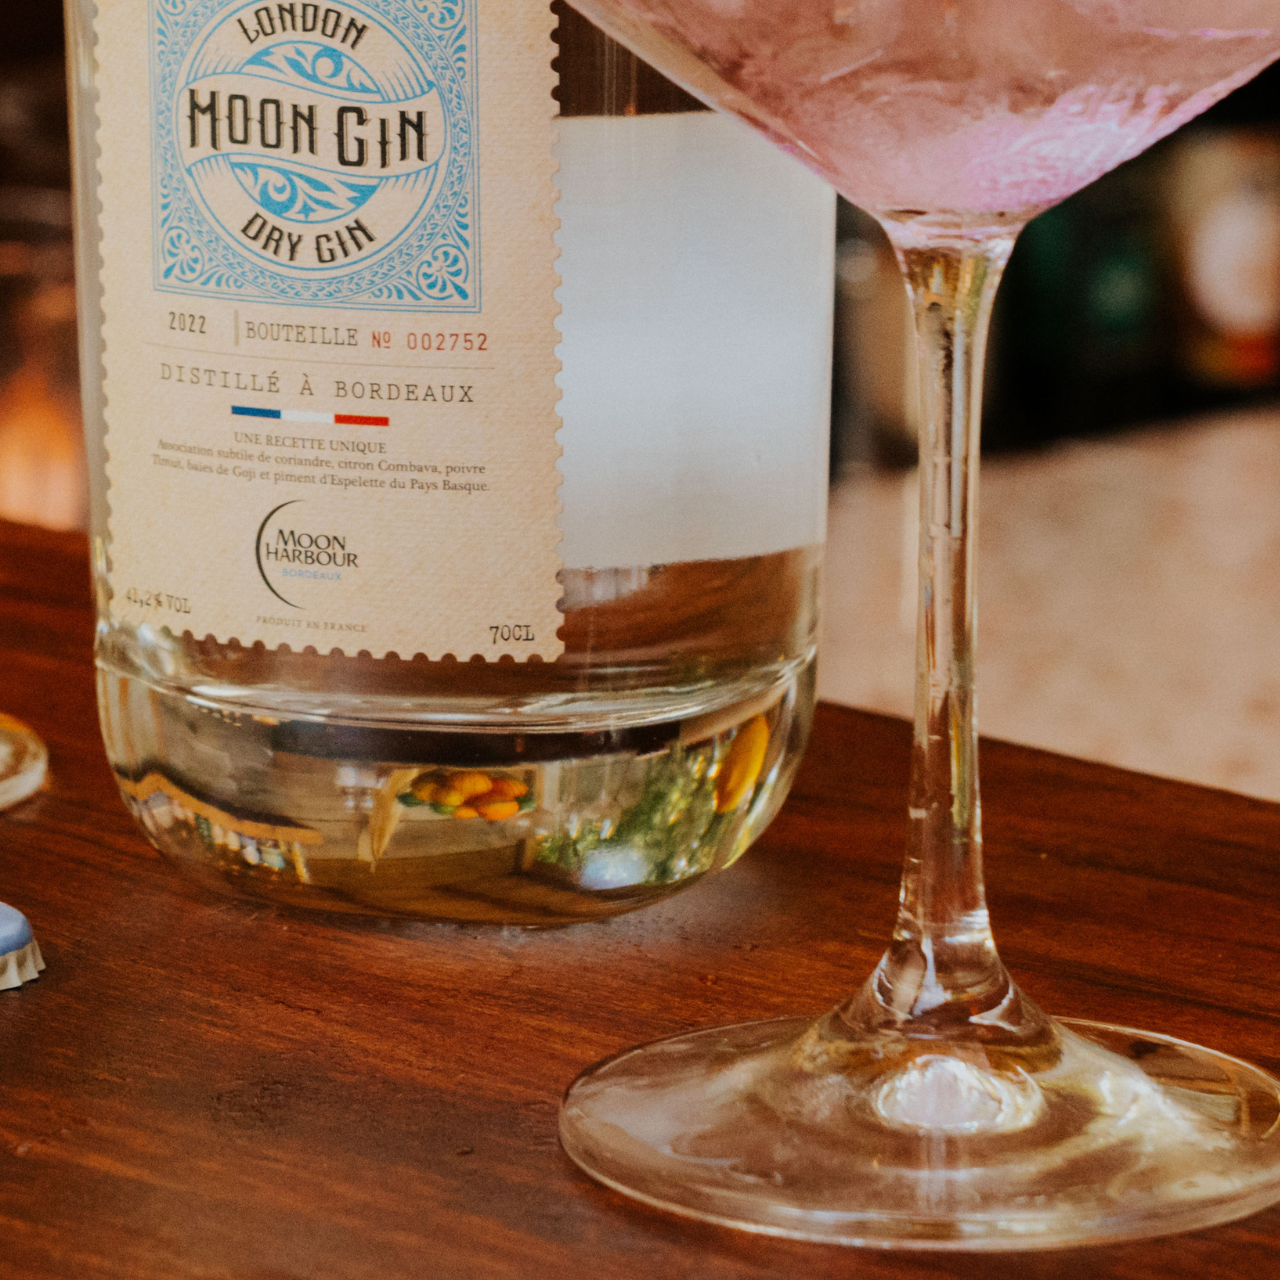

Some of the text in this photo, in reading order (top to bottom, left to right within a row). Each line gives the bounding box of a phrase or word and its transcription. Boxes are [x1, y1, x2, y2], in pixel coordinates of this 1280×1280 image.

[236, 2, 371, 50] LONDON
[187, 88, 430, 169] MOON GIN
[240, 211, 377, 265] DRY GIN
[168, 311, 208, 334] 2022
[245, 321, 359, 347] BOUTEILLE
[406, 332, 489, 351] 002752
[160, 363, 474, 403] DISTILLÉ À BORDEAUX
[157, 439, 486, 477] Association subtile de coriandre, citron Combava, poivre
[233, 431, 387, 455] UNE RECETTE UNIQUE
[186, 460, 214, 474] baies
[216, 464, 229, 476] de
[232, 465, 256, 481] Goji
[259, 470, 270, 480] et
[274, 471, 315, 485] piment
[320, 474, 386, 489] d'Espelette
[389, 478, 406, 489] du
[409, 478, 438, 494] Pays
[442, 480, 490, 495] Basque.
[265, 542, 359, 568] HARBOUR
[276, 529, 346, 551] MOON
[281, 568, 342, 581] BORDEAUX
[256, 615, 367, 633] PRODUIT EN FRANCE
[489, 624, 535, 645] 70CL
